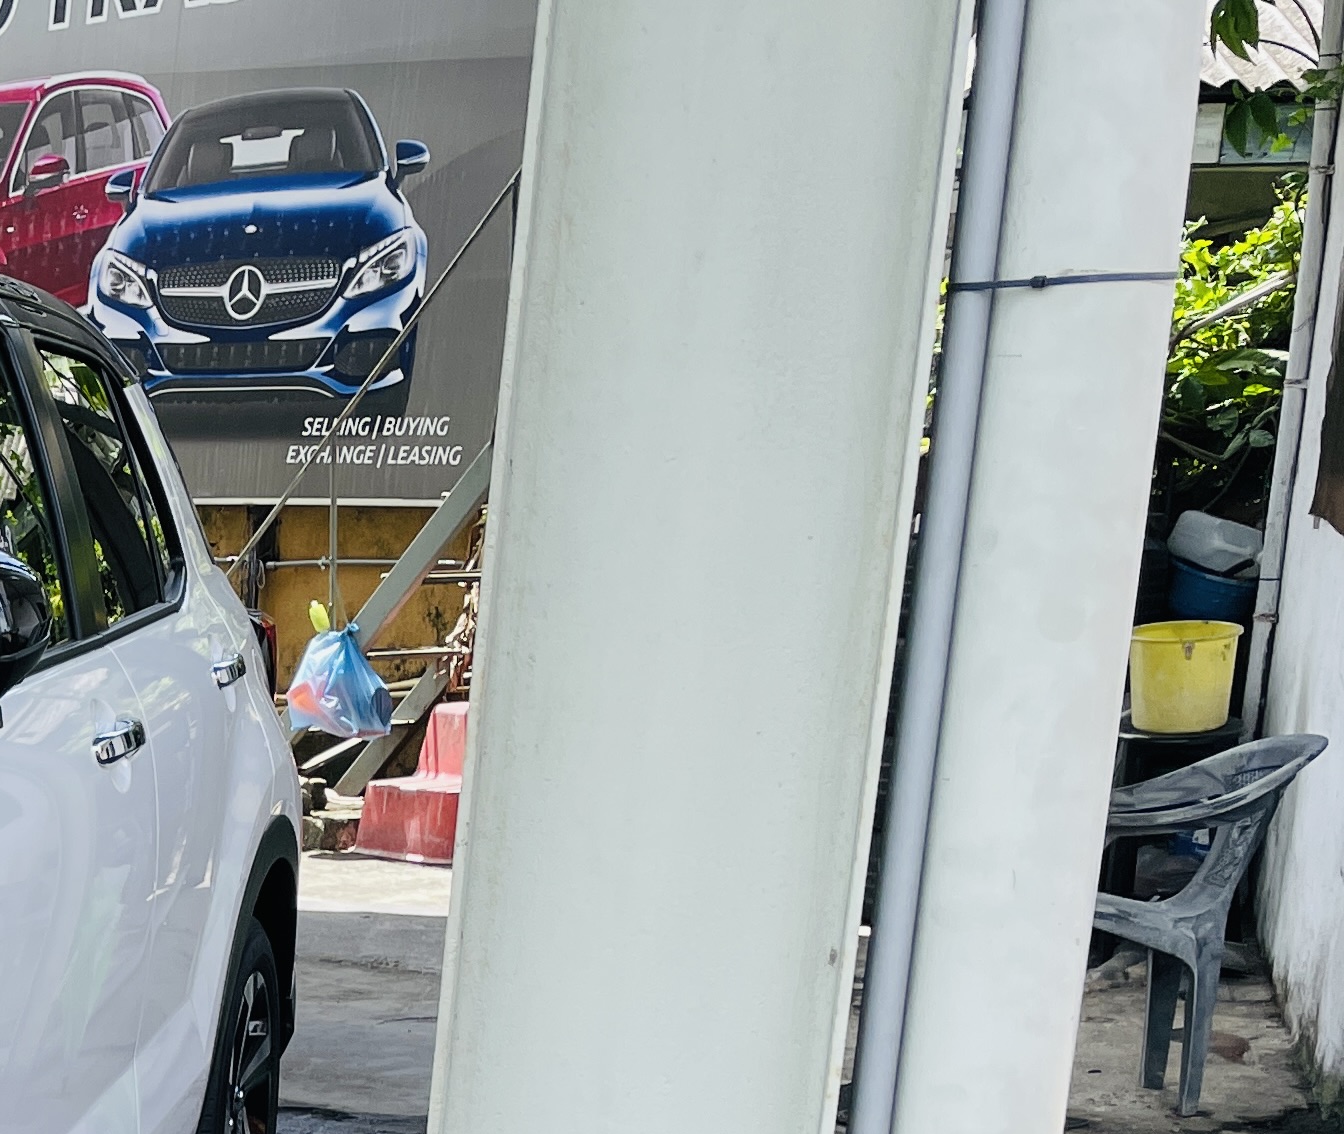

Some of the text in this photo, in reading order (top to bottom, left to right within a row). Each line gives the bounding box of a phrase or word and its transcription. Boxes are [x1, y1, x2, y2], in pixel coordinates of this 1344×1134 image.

[301, 416, 372, 437] SELLING
[382, 416, 450, 437] BUYING
[387, 445, 463, 466] LEASING
